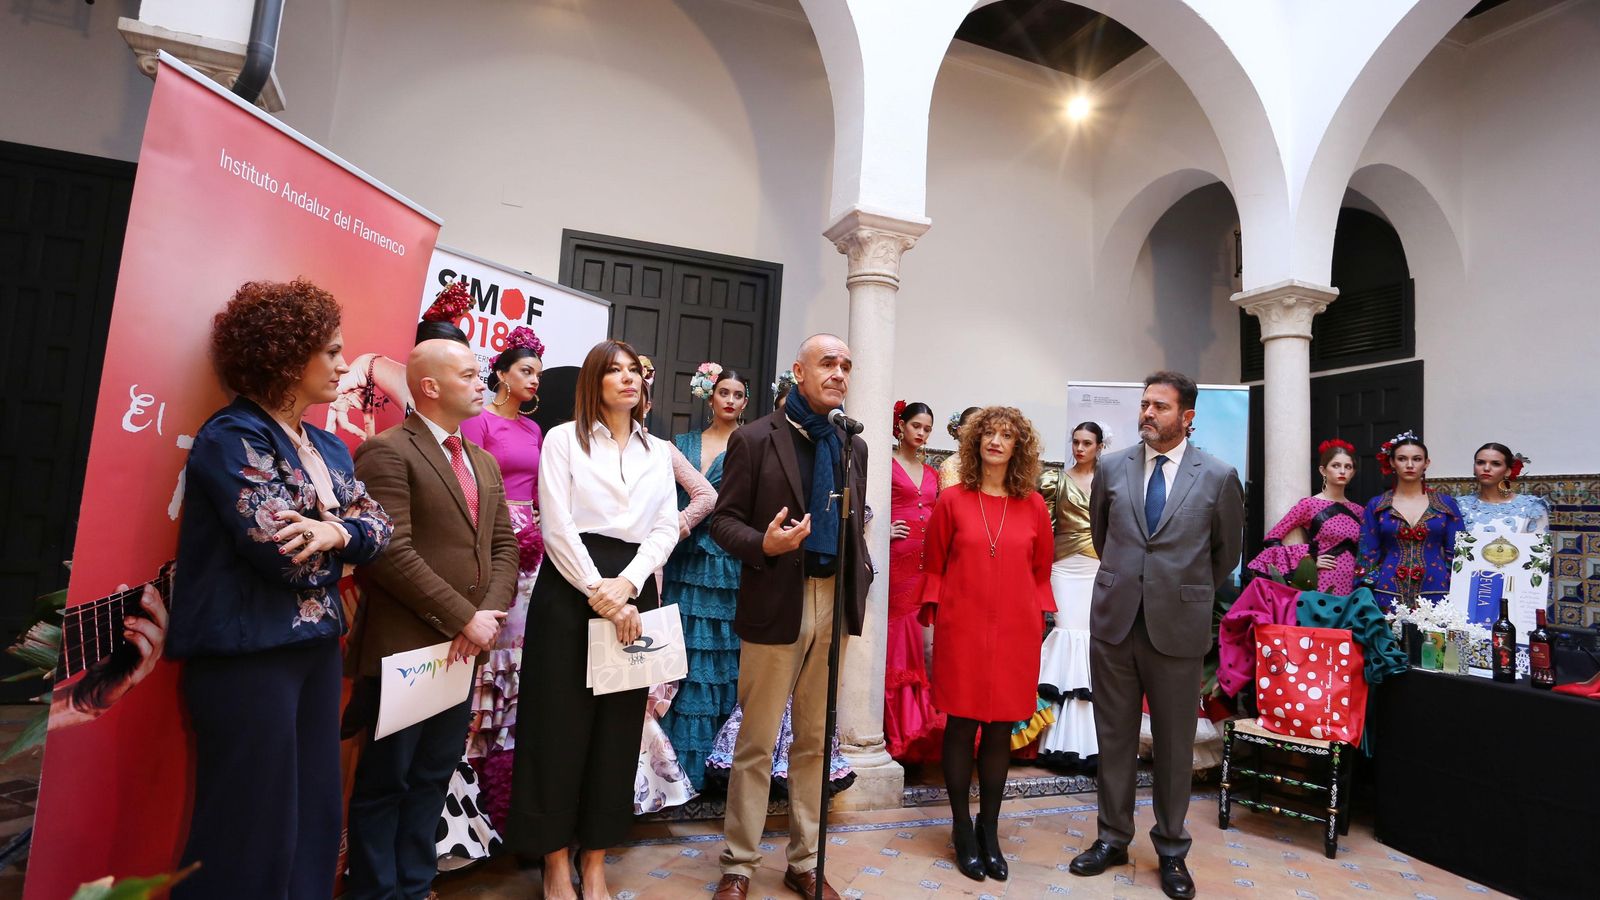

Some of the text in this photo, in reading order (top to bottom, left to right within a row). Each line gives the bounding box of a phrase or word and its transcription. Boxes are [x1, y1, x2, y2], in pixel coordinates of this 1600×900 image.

[219, 148, 405, 256] Instituto Andaluz del Flamenco
[437, 268, 545, 326] SMOF
[455, 312, 510, 353] 018
[121, 383, 166, 436] El
[1477, 570, 1504, 606] SEVILLA
[396, 653, 468, 687] nalucía
